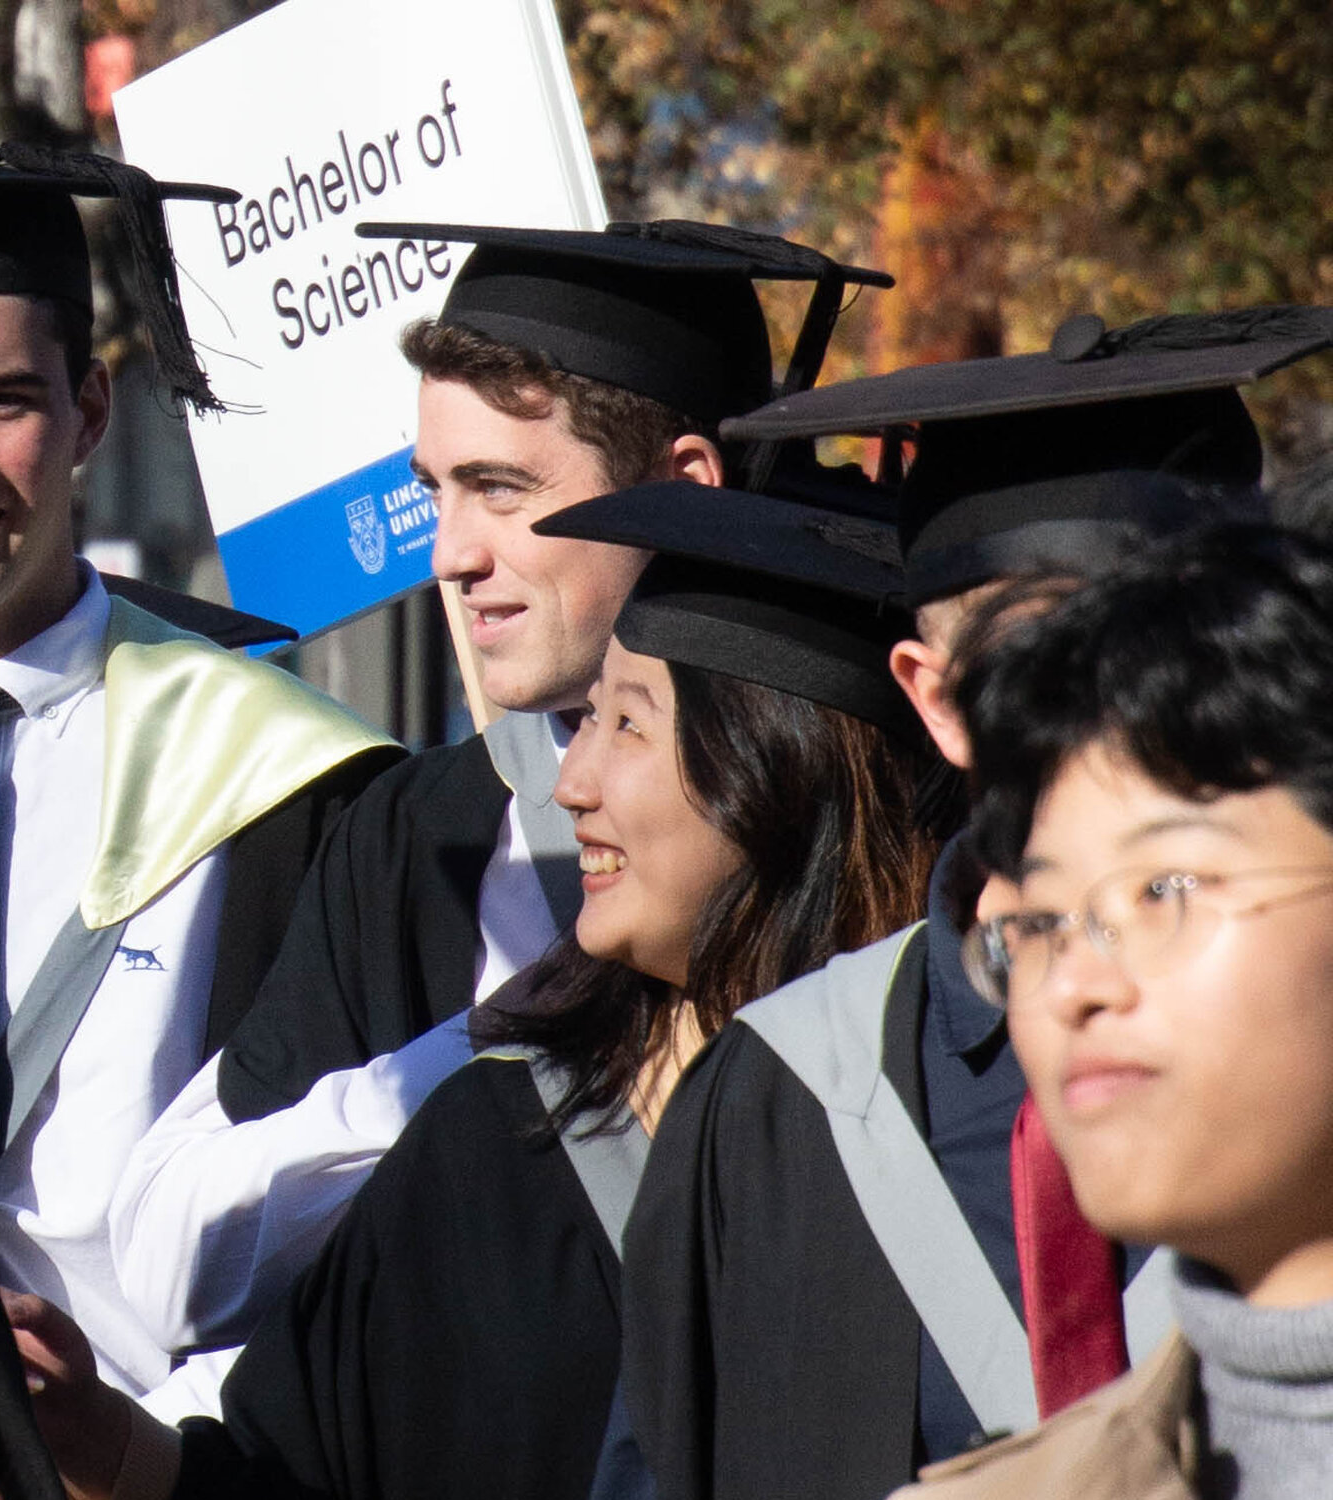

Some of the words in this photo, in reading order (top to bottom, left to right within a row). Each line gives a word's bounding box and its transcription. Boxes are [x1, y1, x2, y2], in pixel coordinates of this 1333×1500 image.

[212, 128, 402, 268] Bachelor
[415, 78, 462, 169] of
[271, 238, 452, 350] Science
